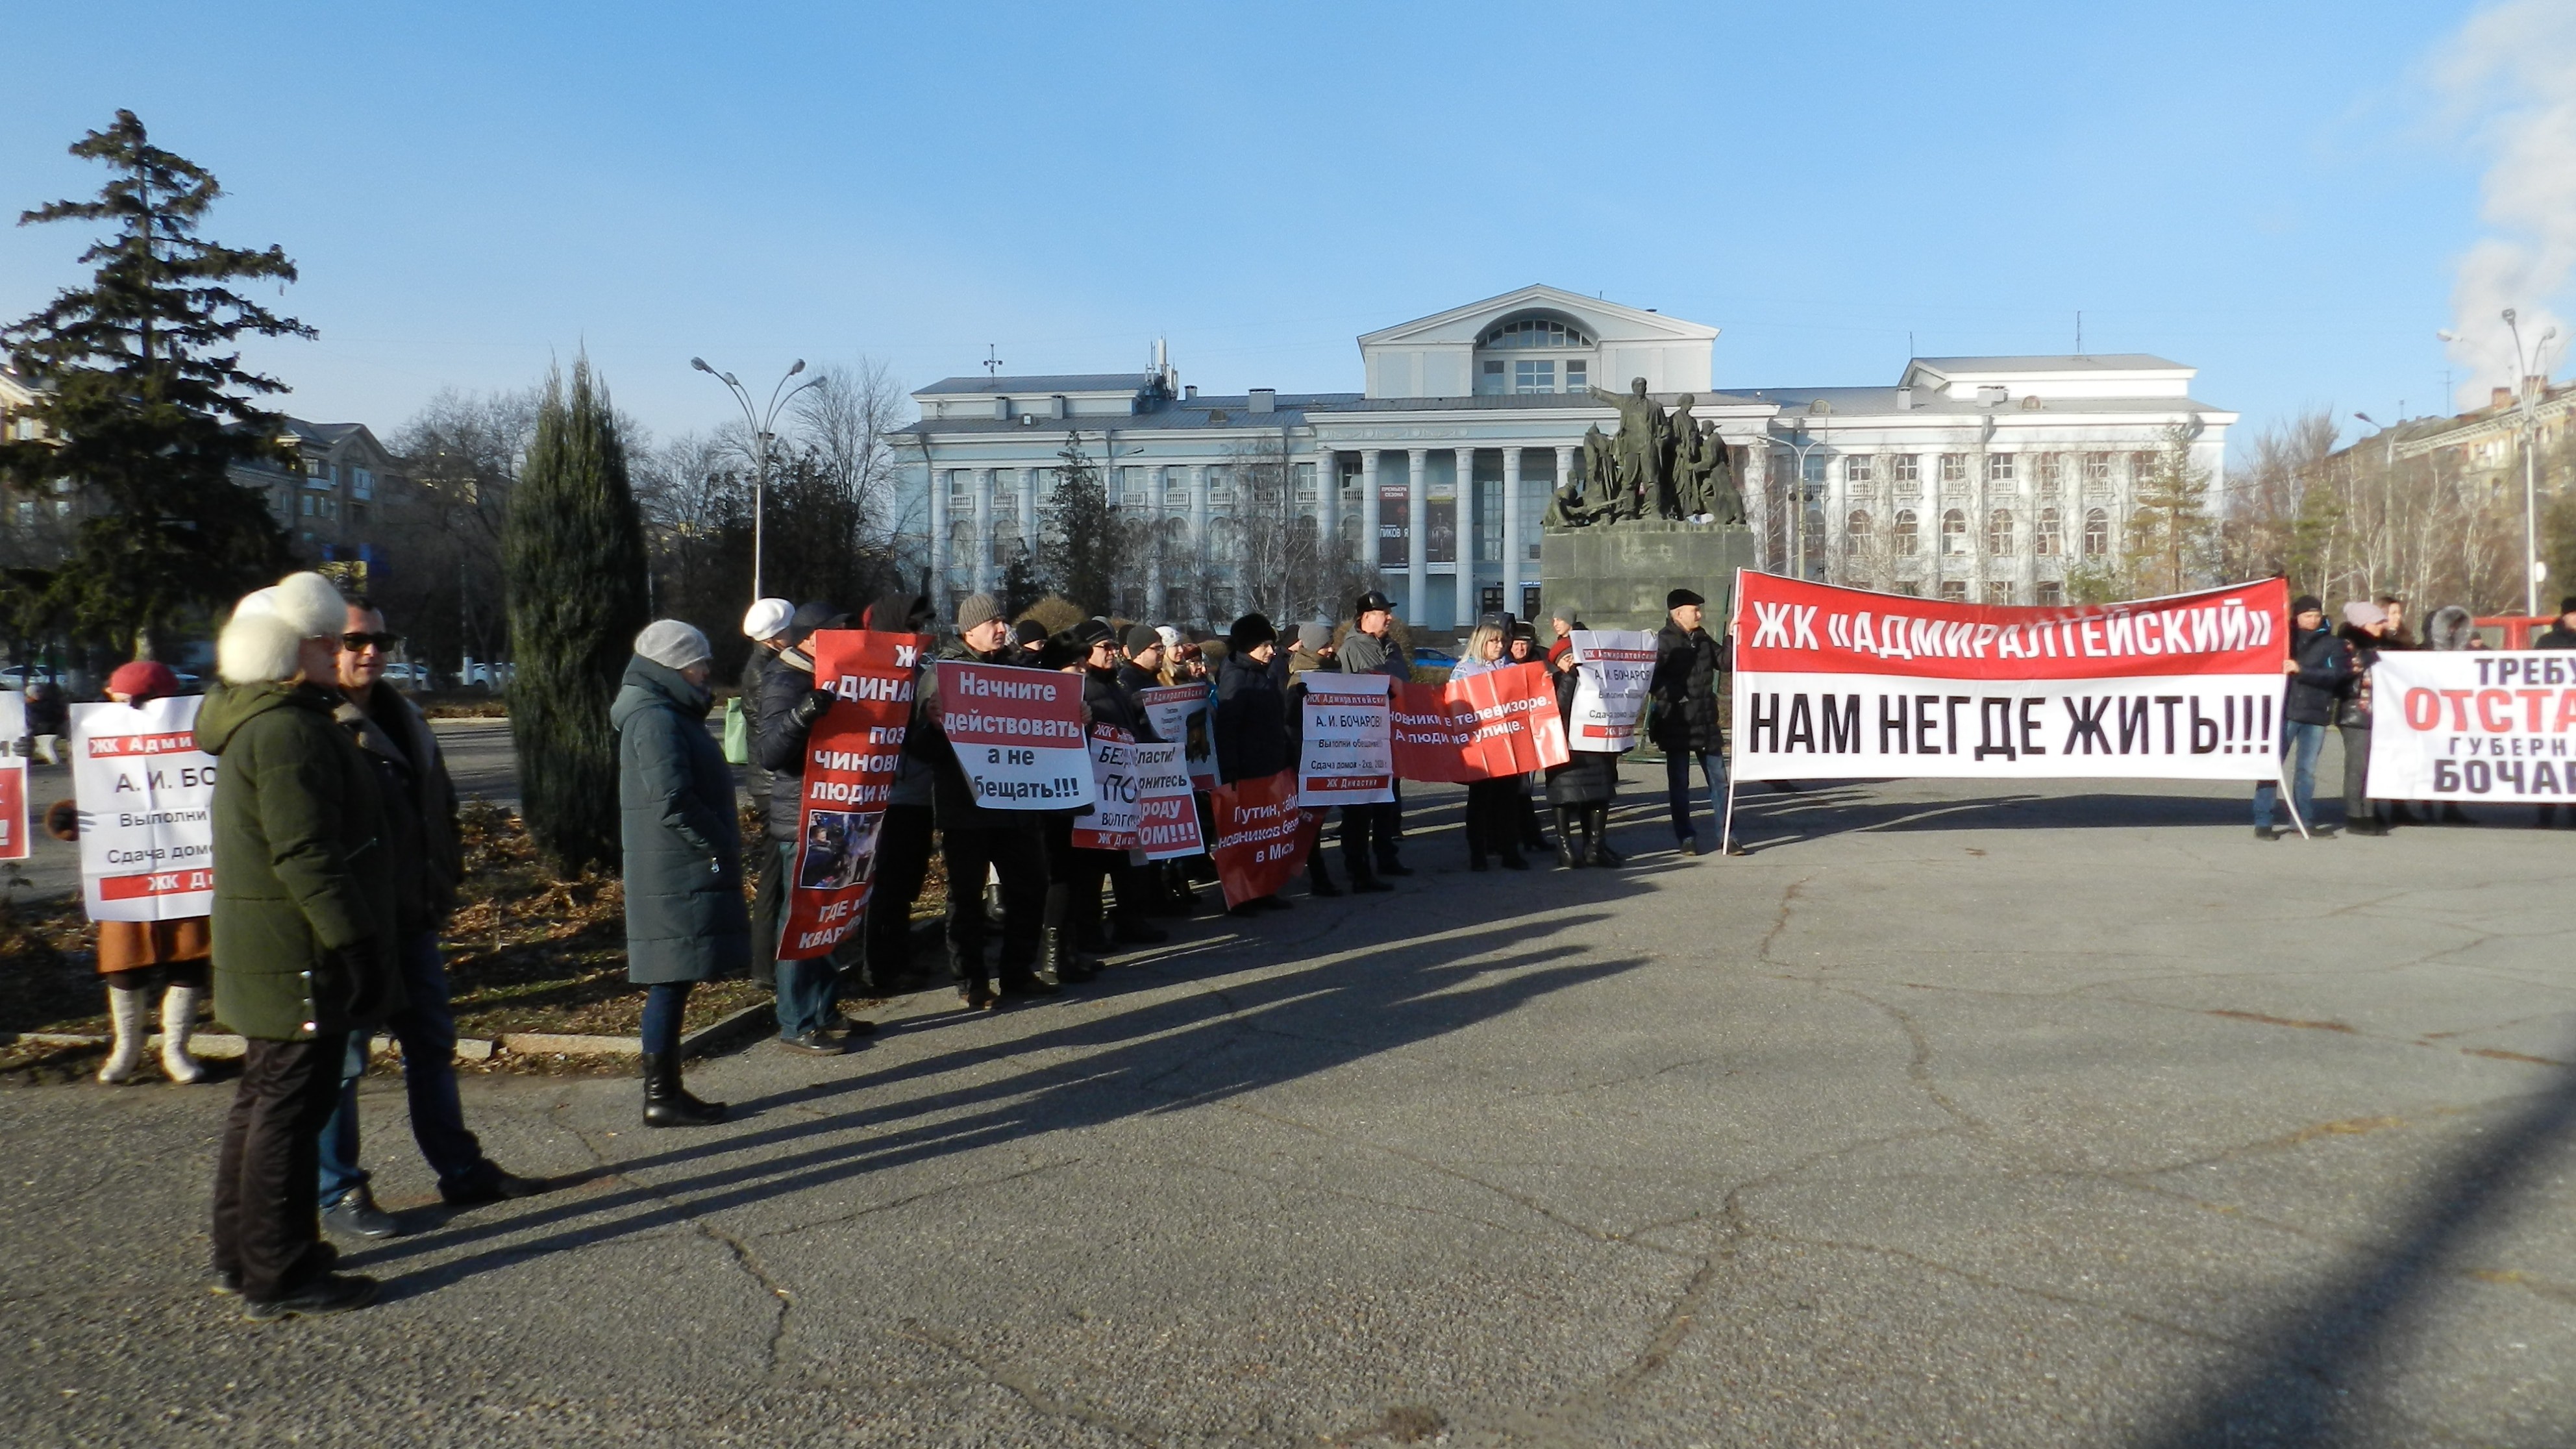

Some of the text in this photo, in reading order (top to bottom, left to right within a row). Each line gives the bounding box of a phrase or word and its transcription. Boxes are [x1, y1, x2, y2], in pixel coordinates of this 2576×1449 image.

[1752, 598, 2272, 660] ЖК «АДМИРАЛТЕЙСКИЙ»
[1583, 650, 1595, 658] ЖК
[821, 675, 914, 702] «ДИНА
[960, 671, 1057, 702] Начните
[1307, 694, 1320, 702] ЖК
[1445, 717, 1452, 727] в
[1455, 695, 1552, 725] телевизоре.
[943, 709, 1080, 737] действовать
[1095, 724, 1115, 737] ЖК
[1316, 715, 1326, 727] А.
[1329, 715, 1338, 727] И.
[1750, 693, 2272, 762] НАМ НЕГДЕ ЖИТЬ!!!
[1396, 719, 1524, 745] А люди на улице.
[90, 739, 119, 754] ЖК
[2449, 737, 2576, 756] ГУБЕРН
[988, 749, 1035, 765] а не
[1135, 747, 1175, 767] ласти!
[1311, 761, 1335, 771] Сдача
[116, 773, 141, 793] А.
[147, 771, 172, 790] И.
[1327, 778, 1337, 787] ЖК
[811, 781, 875, 805] ЛЮДИ
[120, 811, 207, 827] Выполни
[1139, 800, 1181, 822] роду
[1139, 823, 1196, 845] ОМ!!!
[107, 848, 166, 865] Сдача
[1256, 851, 1264, 862] в
[147, 874, 179, 892] ЖК
[818, 900, 848, 923] ГДЕ
